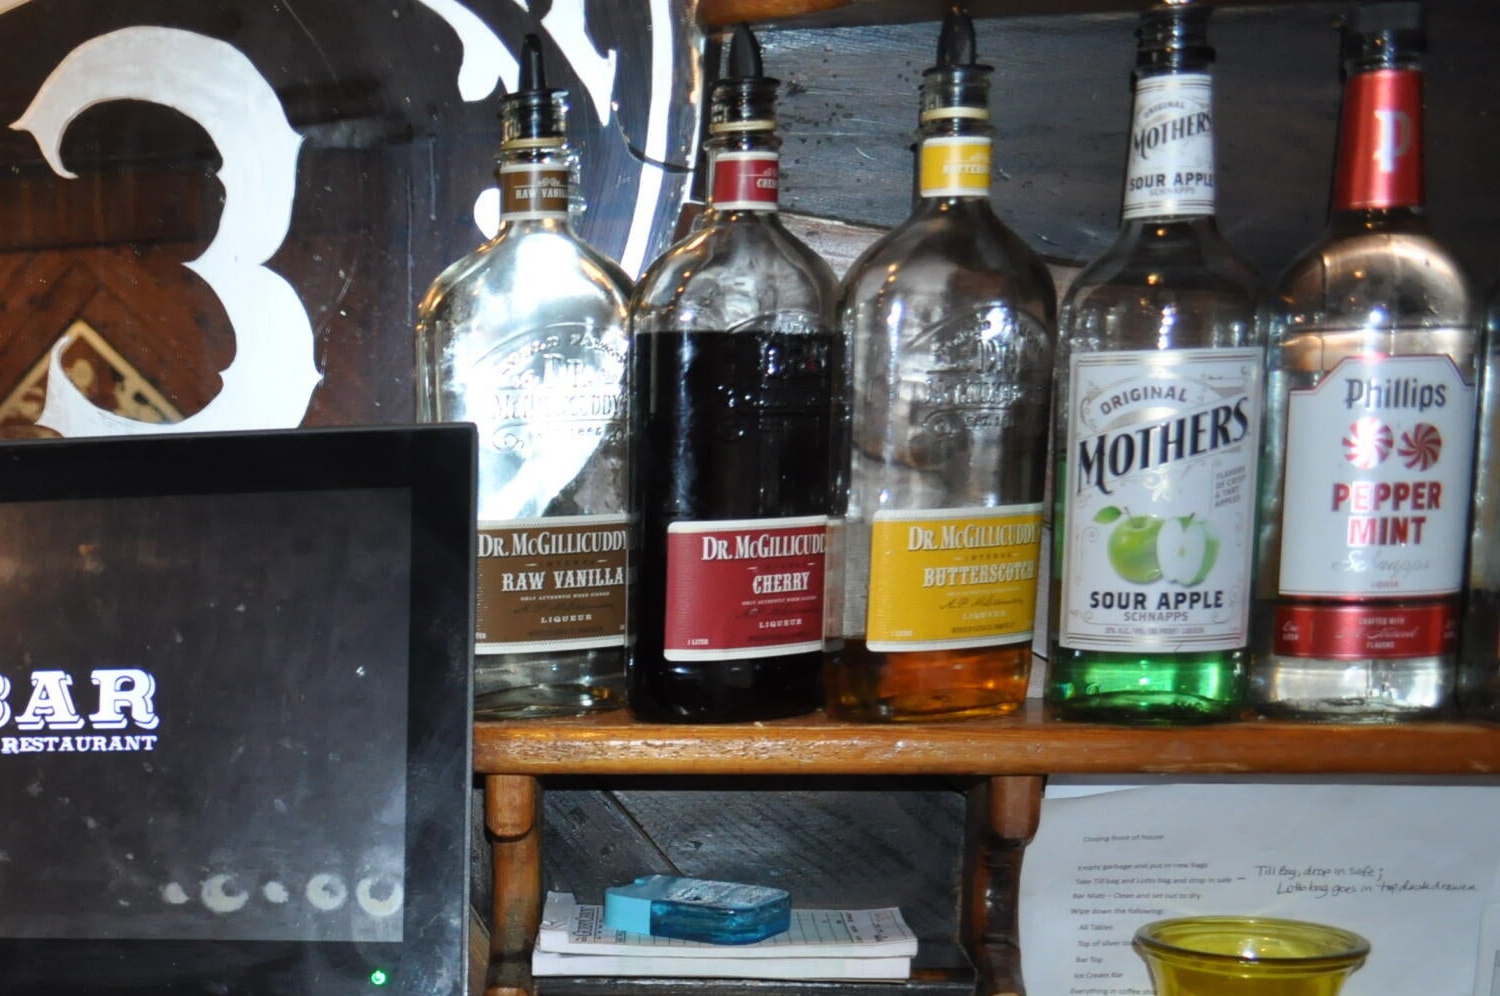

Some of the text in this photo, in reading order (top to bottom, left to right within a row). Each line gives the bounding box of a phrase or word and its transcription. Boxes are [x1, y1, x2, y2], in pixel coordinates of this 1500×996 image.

[1132, 111, 1213, 160] MOTHERS
[1129, 171, 1213, 191] SOUR APPLE
[515, 187, 536, 200] RAW
[1100, 385, 1188, 415] ORIGINAL
[1344, 377, 1447, 412] Phillips
[1076, 396, 1249, 495] MOTHERS
[1216, 465, 1247, 480] FLAVORS
[1331, 481, 1442, 512] PEPPER
[907, 526, 938, 552] DR.
[1347, 515, 1427, 547] MINT
[701, 536, 733, 561] DR.
[501, 566, 625, 592] RAW VANILLA
[923, 560, 1036, 588] BUTTERSCOTCH
[752, 571, 811, 595] CHERRY
[1090, 590, 1223, 610] SOUR APPLE
[540, 613, 593, 624] LIQUEUR
[759, 618, 803, 629] LIQUEUR
[1123, 611, 1189, 622] SCHNAPPS
[1358, 616, 1405, 625] CRAFTED WITH
[1366, 641, 1396, 649] FLAVORS
[0, 735, 158, 755] RESTAURANT
[1102, 863, 1132, 872] garbage
[1255, 865, 1276, 877] Till
[1070, 907, 1126, 916] Wipe down the
[1078, 940, 1091, 948] Top
[1076, 956, 1103, 965] Bar Top
[1086, 971, 1110, 979] Cream
[1111, 971, 1123, 979] Bar
[1070, 987, 1141, 996] Everything coffee
